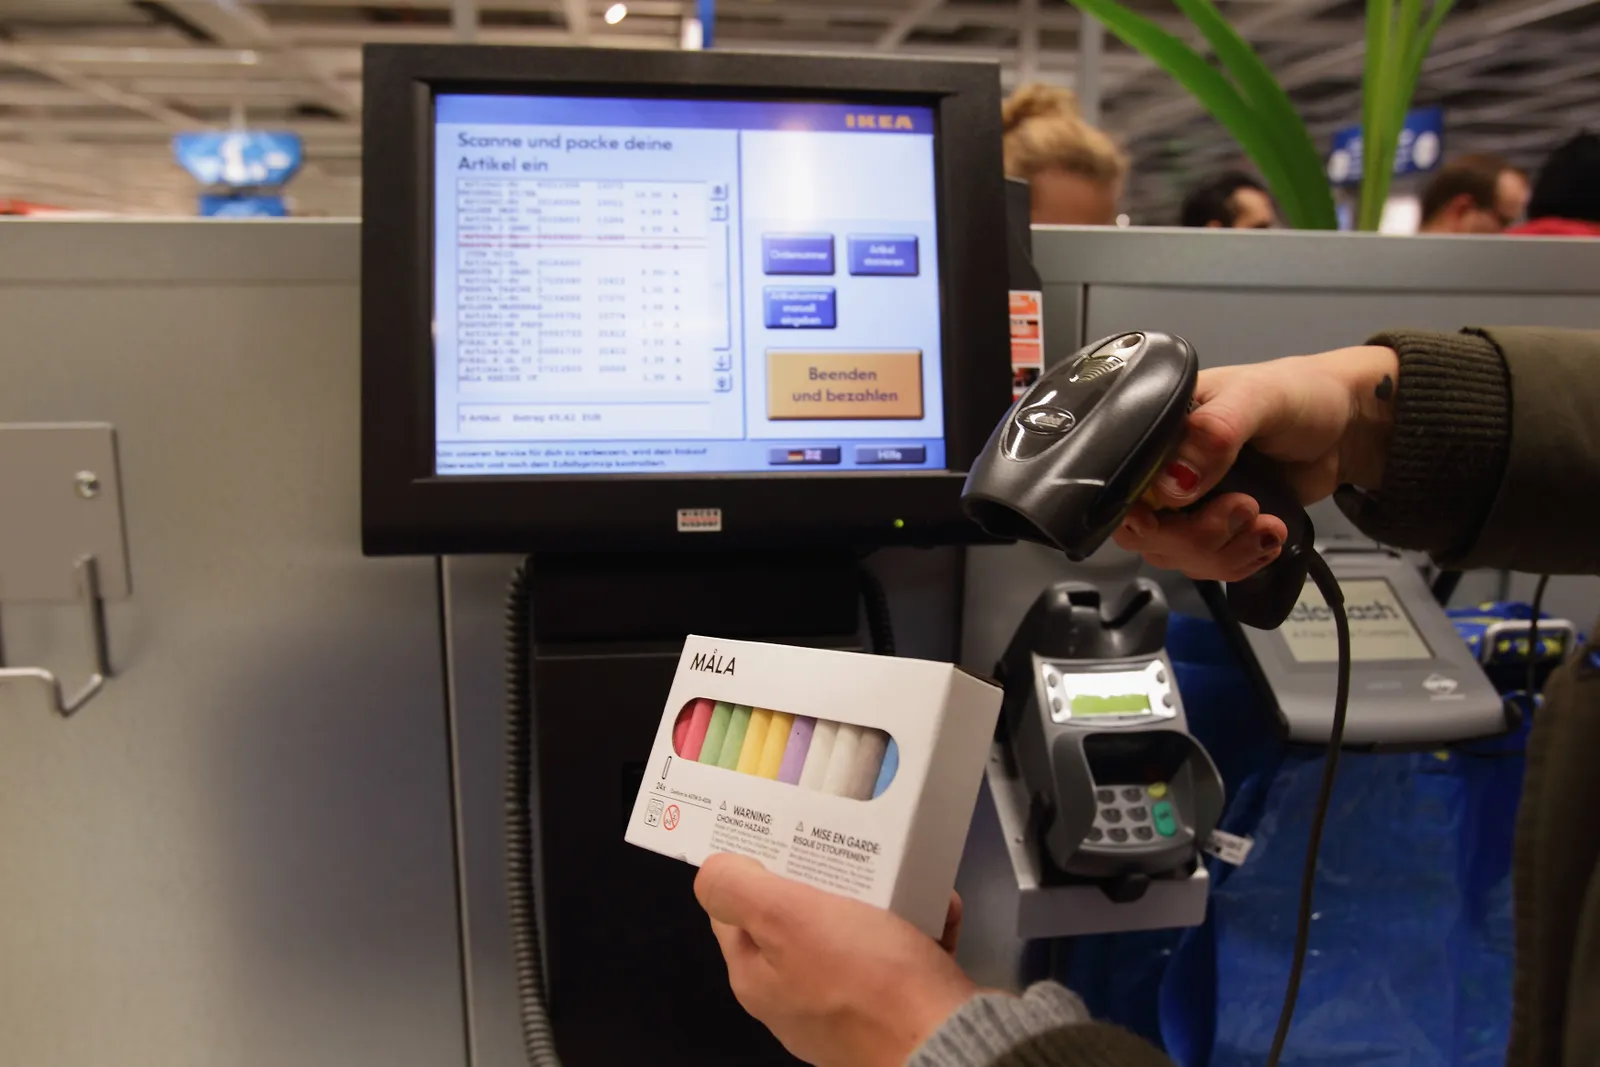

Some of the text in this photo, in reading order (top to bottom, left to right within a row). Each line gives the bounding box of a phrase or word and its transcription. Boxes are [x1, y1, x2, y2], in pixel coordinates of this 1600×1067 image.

[845, 113, 913, 129] IKEA
[457, 131, 673, 153] Scanne und packe deine
[457, 156, 549, 172] Artikel ein
[808, 366, 878, 382] Beenden
[792, 388, 899, 404] und bezahlen
[689, 648, 737, 677] MÅLA
[655, 781, 667, 792] 24x
[733, 805, 774, 826] WARNING:
[716, 813, 771, 836] CHOKING HAZARD
[793, 835, 816, 849] RISQUE
[810, 826, 882, 855] MISE EN GARDE:
